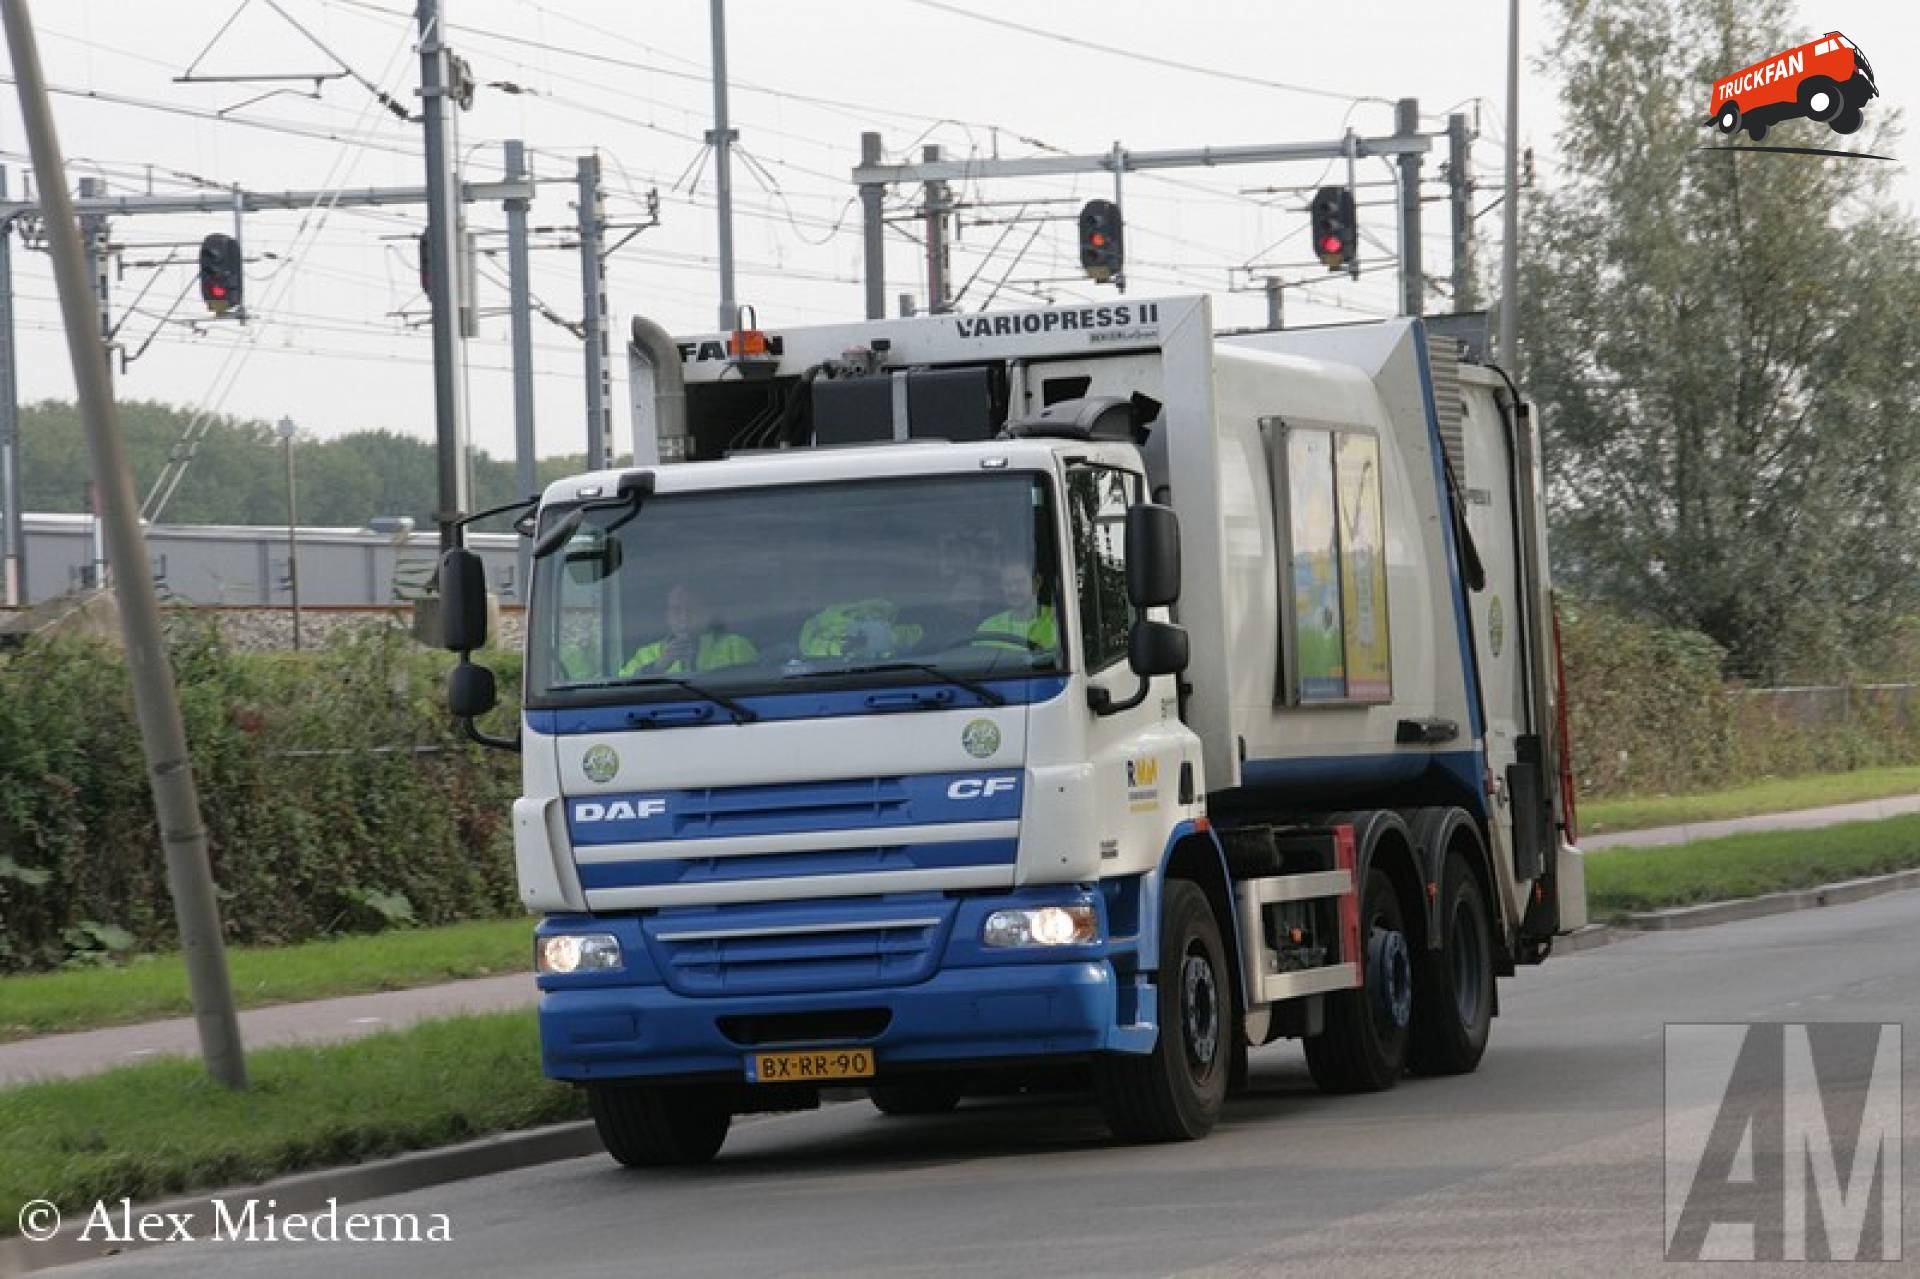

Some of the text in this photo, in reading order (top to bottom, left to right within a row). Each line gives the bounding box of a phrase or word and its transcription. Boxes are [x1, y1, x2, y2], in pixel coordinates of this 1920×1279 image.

[957, 306, 1131, 338] VARIOPRESS
[1139, 304, 1158, 324] II
[677, 335, 783, 363] FAN
[947, 776, 1016, 799] CF
[575, 798, 665, 822] DAF
[762, 1053, 867, 1078] BX-RR-90
